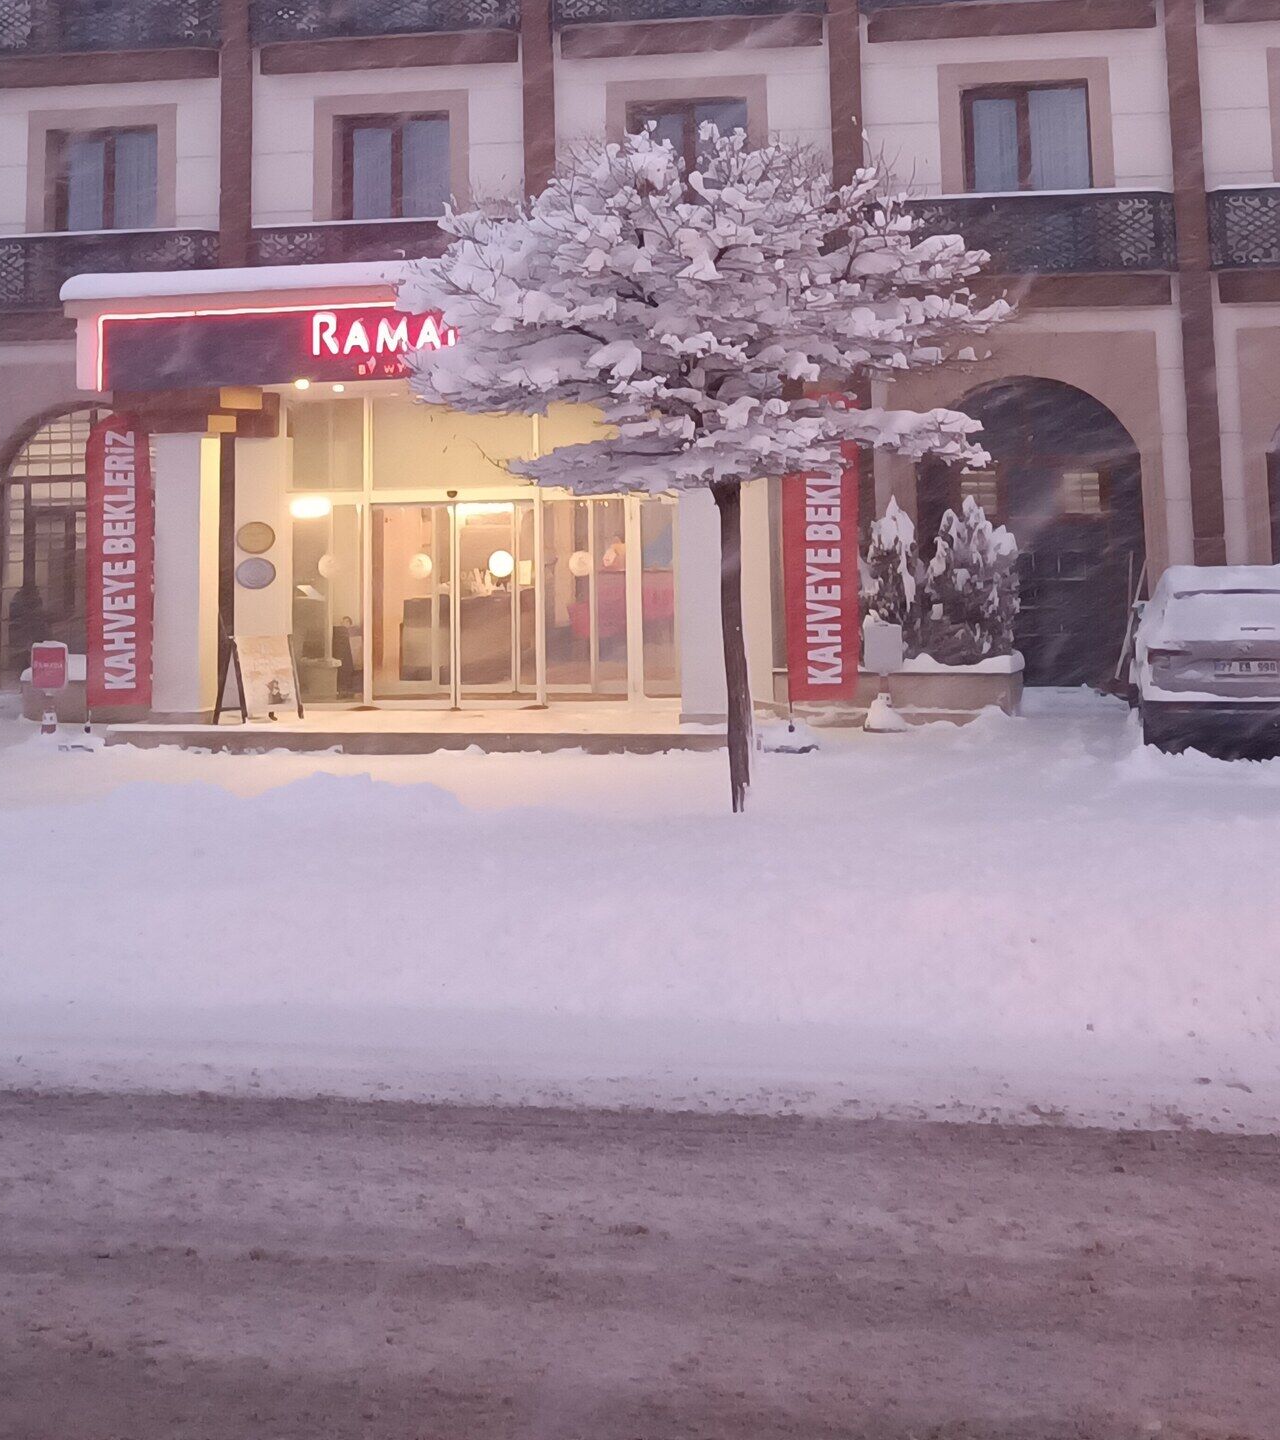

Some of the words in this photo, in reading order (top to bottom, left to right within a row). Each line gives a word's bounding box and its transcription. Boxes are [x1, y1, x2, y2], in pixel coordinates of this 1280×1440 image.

[312, 311, 457, 356] RAMA
[806, 464, 842, 541] BEKL
[103, 560, 136, 690] KAHVEYE
[806, 548, 842, 685] KAHVEYE
